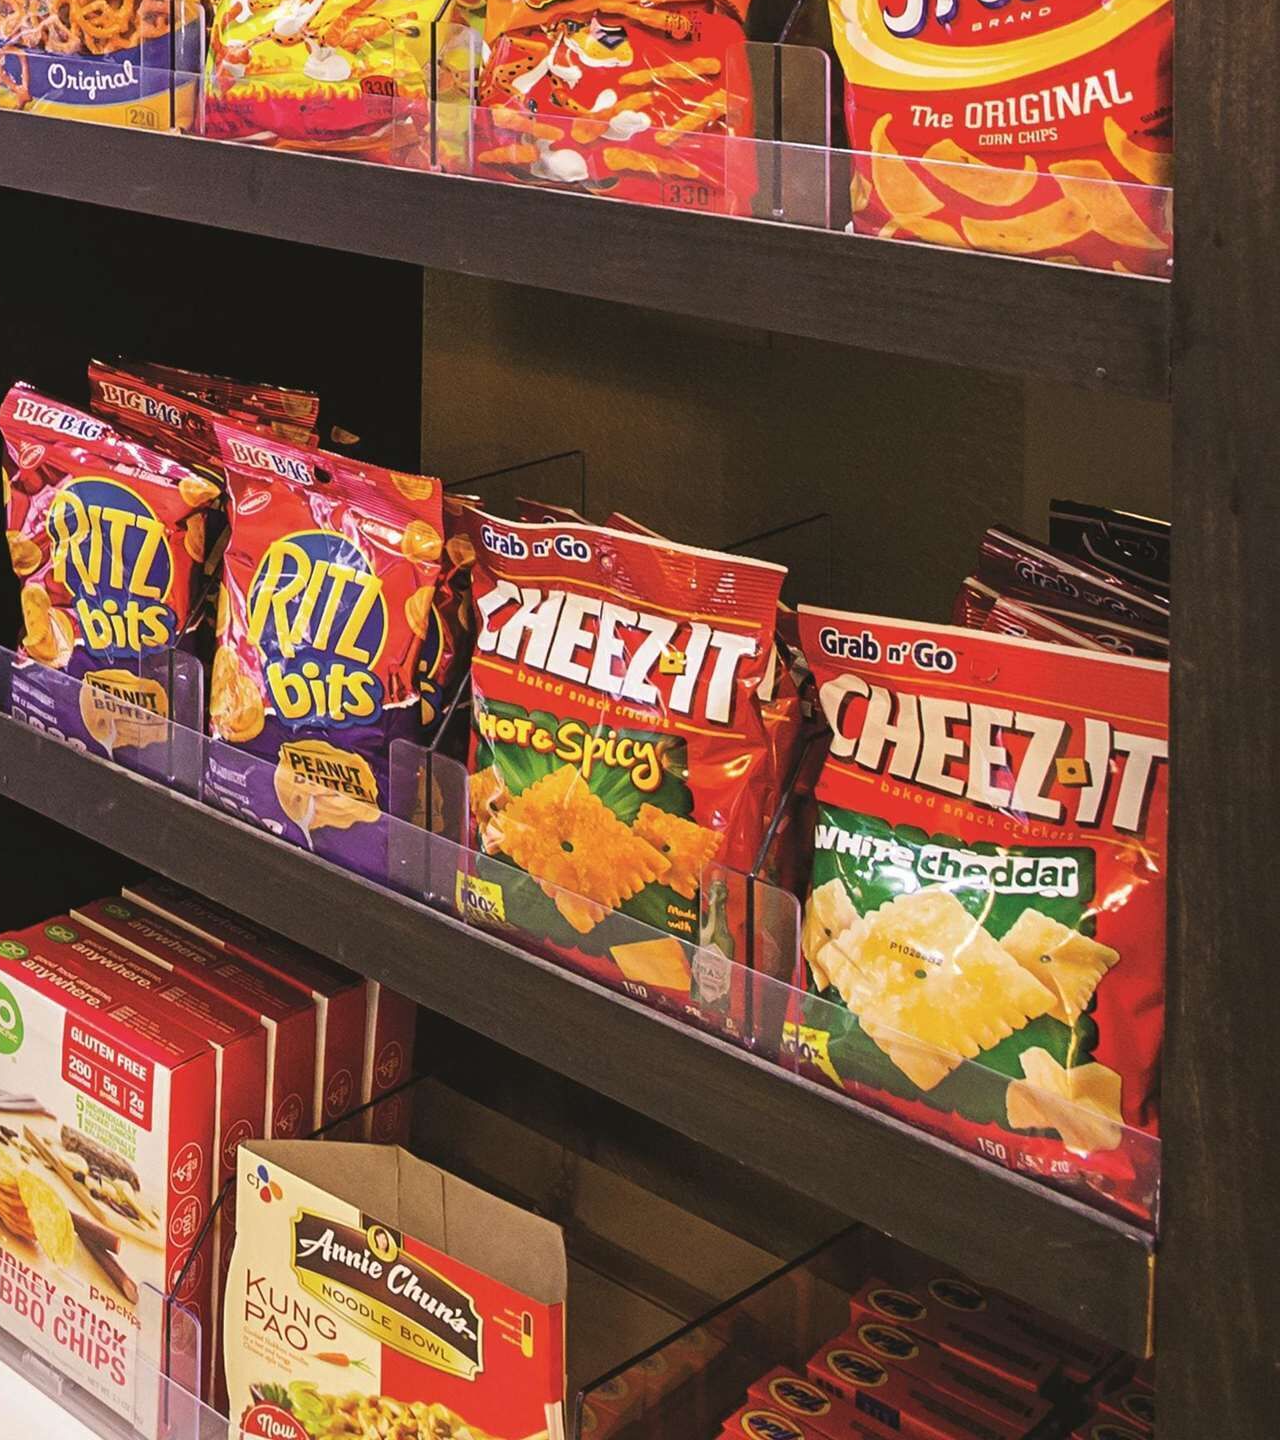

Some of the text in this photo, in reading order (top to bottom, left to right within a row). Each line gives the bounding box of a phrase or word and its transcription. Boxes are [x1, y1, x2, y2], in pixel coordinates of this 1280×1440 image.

[970, 6, 1053, 33] BRAND
[47, 63, 140, 101] Original
[362, 77, 396, 98] 330
[910, 104, 954, 129] The
[964, 68, 1134, 130] ORIGINAL
[977, 127, 1059, 146] CORN CHIPS
[668, 182, 710, 206] 330
[14, 398, 103, 441] BIG BAG
[101, 380, 183, 428] BIG BAG
[229, 440, 315, 486] BIG BAG
[48, 488, 169, 599] RITZ
[481, 525, 591, 561] Grab n' Go
[77, 598, 172, 651] bits
[247, 541, 384, 664] RITZ
[819, 626, 956, 674] Grab n' Go
[88, 680, 159, 711] PEANUT
[267, 665, 378, 720] bits
[517, 669, 672, 729] baked snack crackers
[289, 752, 363, 785] PEANUT
[554, 723, 665, 792] Spicy
[880, 780, 1077, 844] baked snack crackers
[813, 824, 916, 865] WHITE
[920, 845, 1078, 895] cheddar
[667, 904, 698, 922] Made
[667, 918, 692, 933] with
[21, 960, 101, 1010] anywhere.
[71, 941, 152, 990] anywhere.
[622, 980, 649, 1000] 150
[68, 1055, 92, 1079] 260
[70, 1026, 147, 1082] GLUTEN FREE
[75, 1093, 86, 1112] 5
[102, 1074, 119, 1098] 5g
[129, 1089, 145, 1114] 2g
[976, 1135, 1007, 1160] 150
[1050, 1158, 1070, 1173] 210
[245, 1268, 339, 1342] KUNG
[296, 1228, 478, 1341] Annie Chun's
[63, 1295, 128, 1359] STICK
[244, 1300, 310, 1353] PAO
[321, 1282, 452, 1365] NOODLE BOWL
[52, 1314, 128, 1388] CHIPS
[256, 1413, 299, 1440] Now
